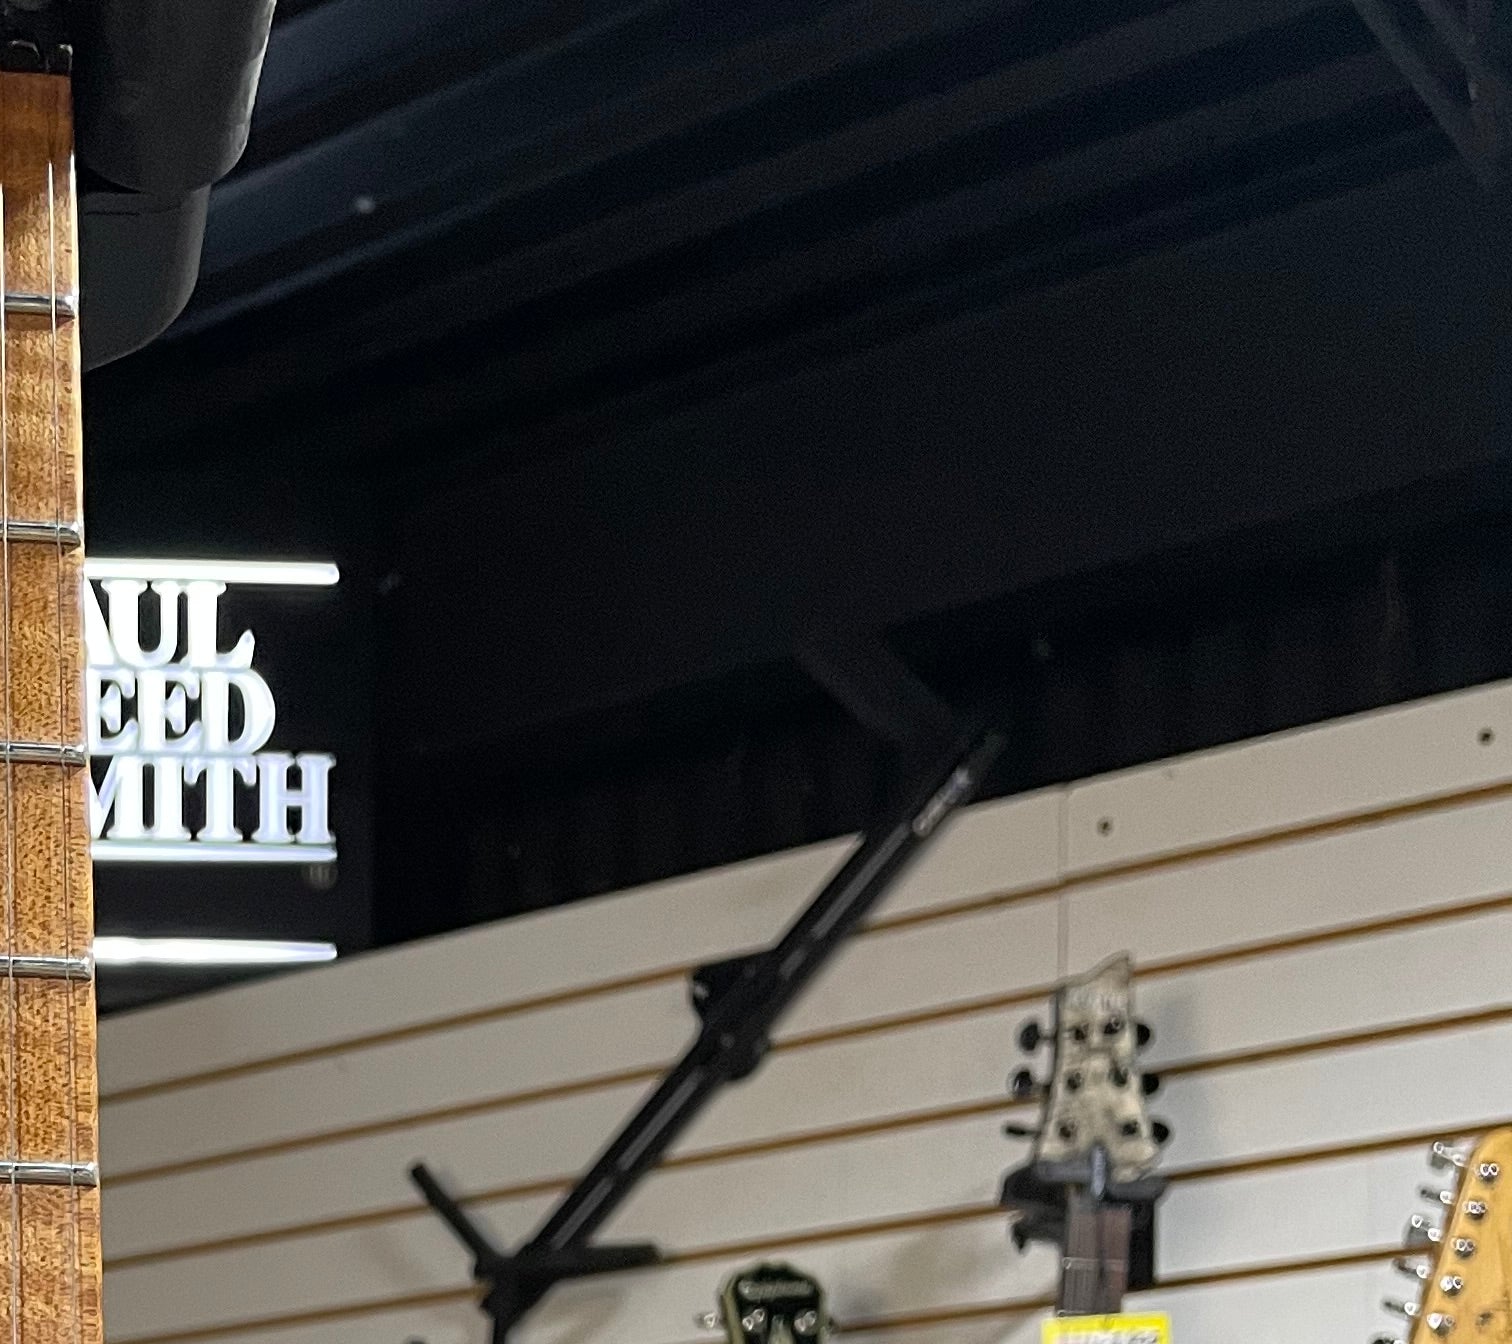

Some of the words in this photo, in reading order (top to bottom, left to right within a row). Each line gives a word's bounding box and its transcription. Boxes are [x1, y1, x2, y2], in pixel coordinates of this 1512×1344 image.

[87, 579, 255, 668] AUL
[88, 668, 276, 755] EED
[89, 754, 337, 844] MITH
